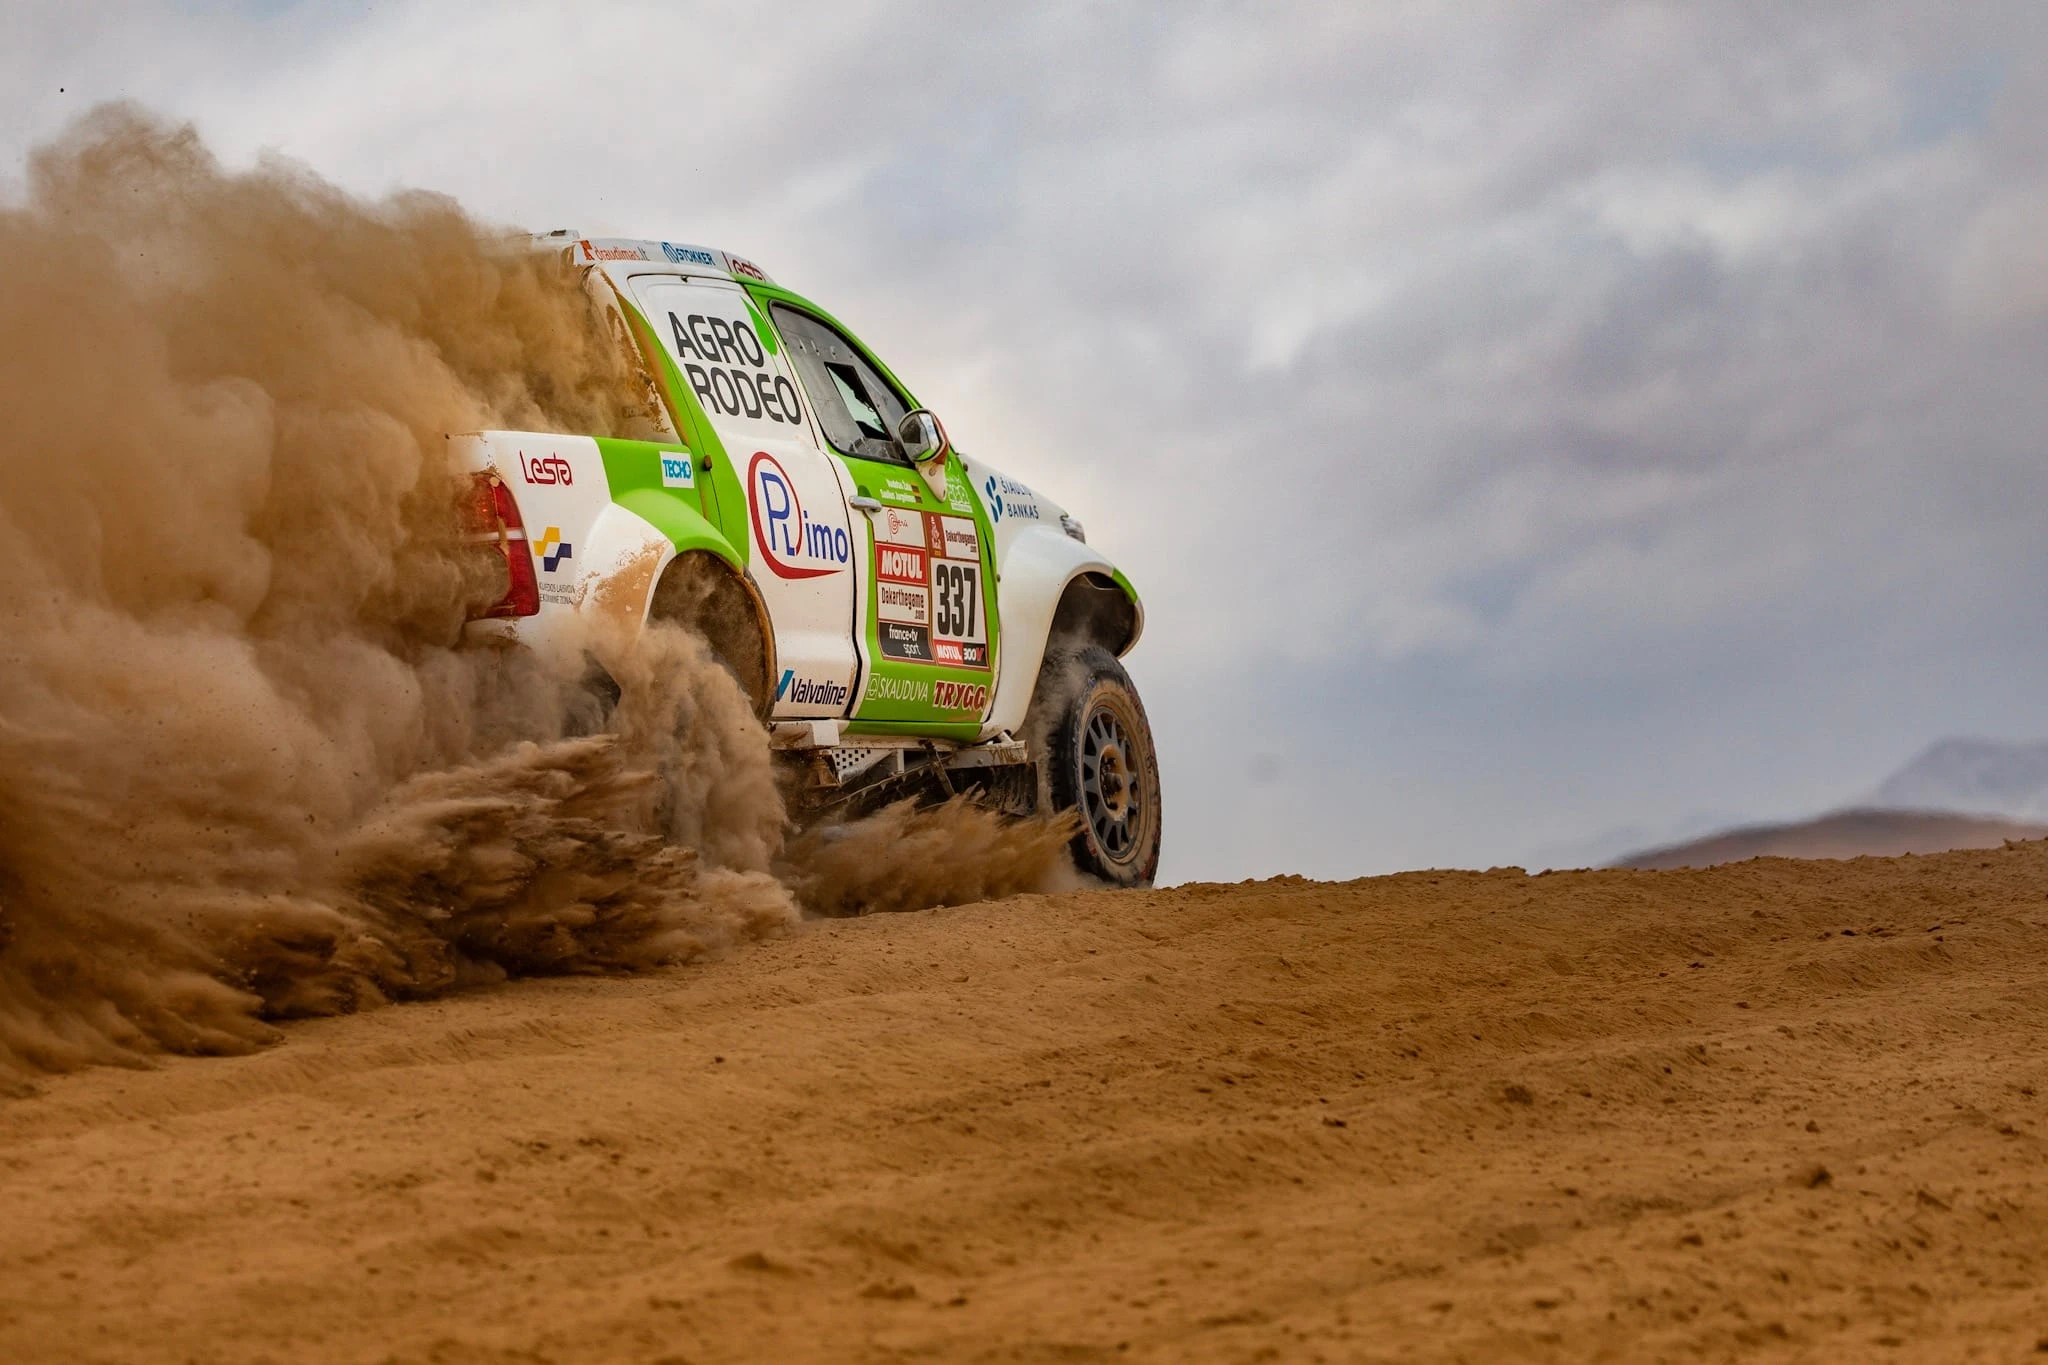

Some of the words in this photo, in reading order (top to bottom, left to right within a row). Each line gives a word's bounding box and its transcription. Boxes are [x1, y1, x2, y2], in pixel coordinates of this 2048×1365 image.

[677, 248, 715, 266] STOKKER
[668, 311, 765, 368] AGRO
[684, 363, 801, 425] RODEO
[519, 450, 573, 485] Lesta
[663, 459, 692, 479] TECHO
[1007, 503, 1039, 520] BANKAS
[881, 550, 922, 579] MOTUL
[882, 586, 924, 610] Dakarthegame
[936, 564, 976, 637] 337
[903, 643, 921, 658] sport
[935, 644, 963, 661] MOTUL
[963, 647, 985, 661] 300V
[791, 678, 847, 705] Valvoline
[878, 676, 929, 702] SKAUDUVA
[932, 680, 987, 712] TRYGG
